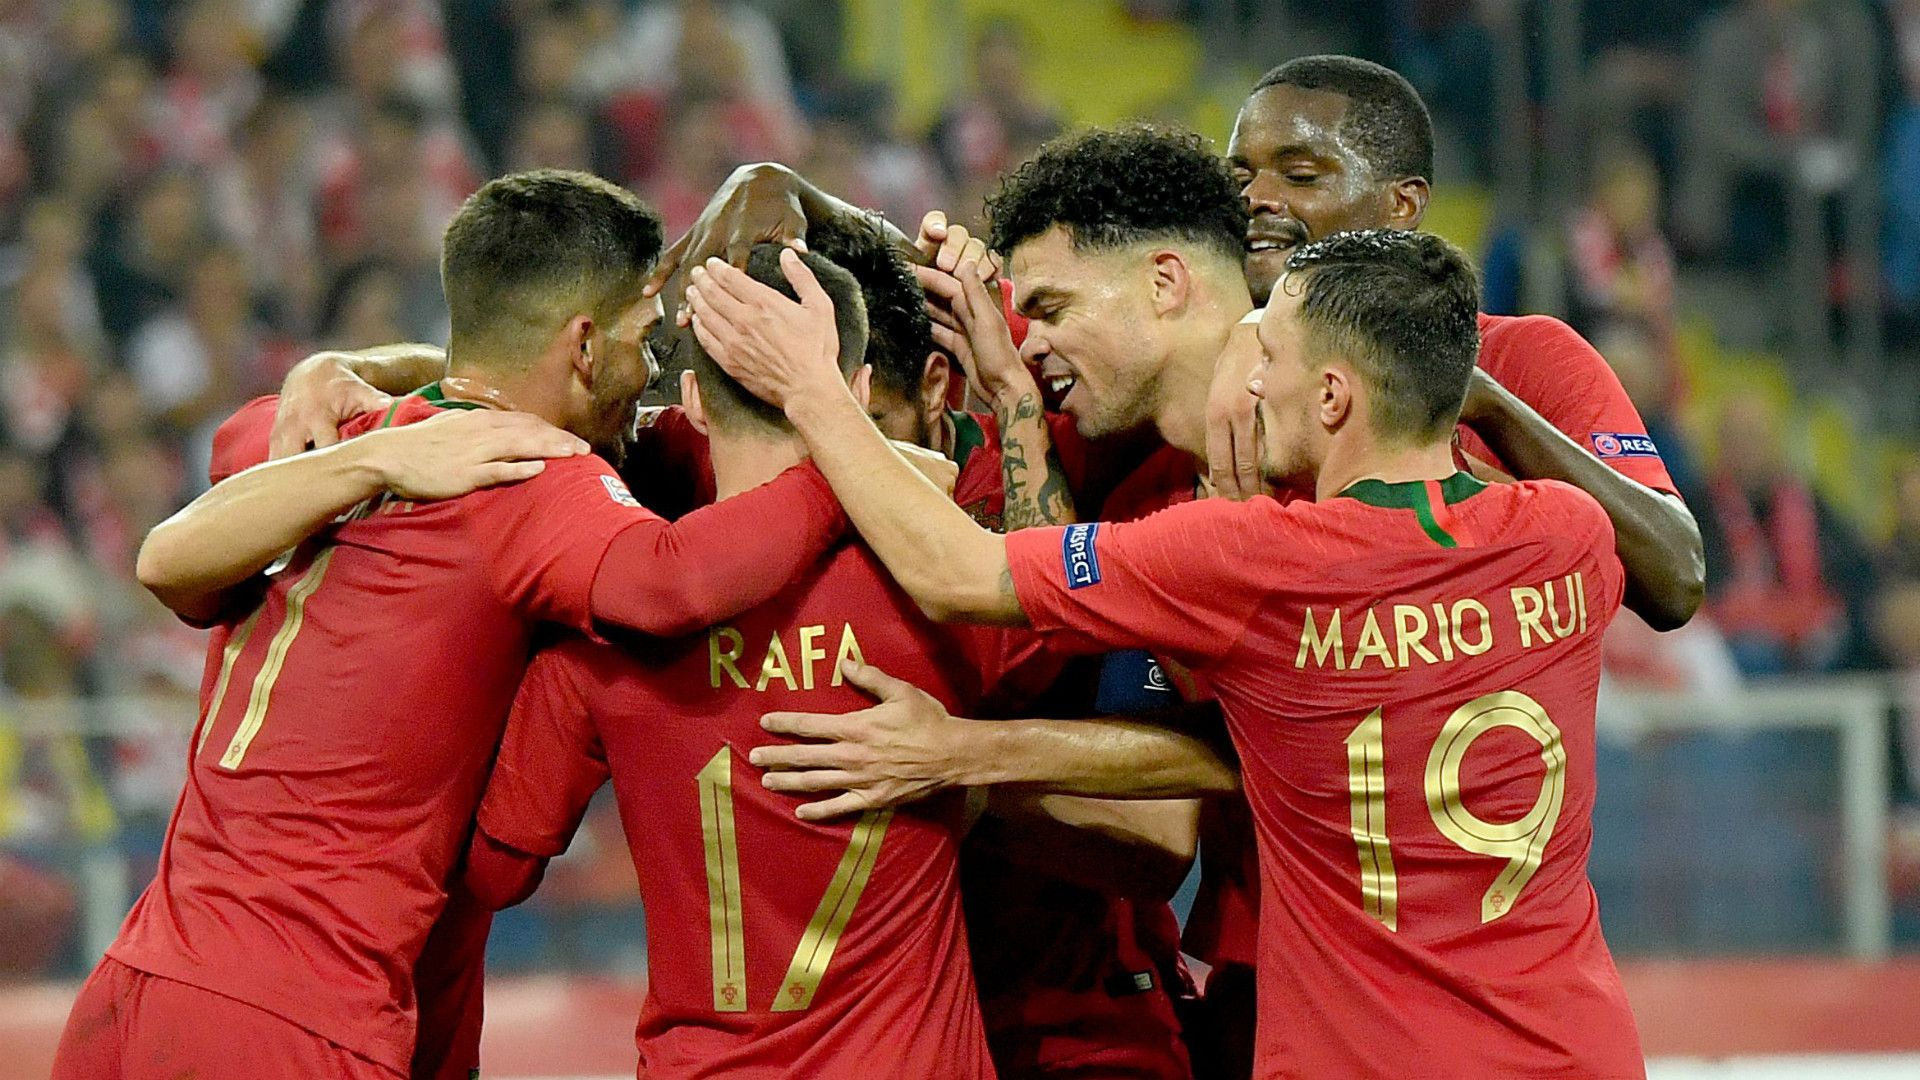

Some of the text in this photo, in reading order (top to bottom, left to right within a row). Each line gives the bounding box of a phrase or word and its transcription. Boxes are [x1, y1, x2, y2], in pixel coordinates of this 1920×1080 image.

[709, 622, 865, 692] RAFA
[1510, 572, 1587, 648] RUI
[694, 743, 894, 1012] 17
[1343, 690, 1567, 933] 19
